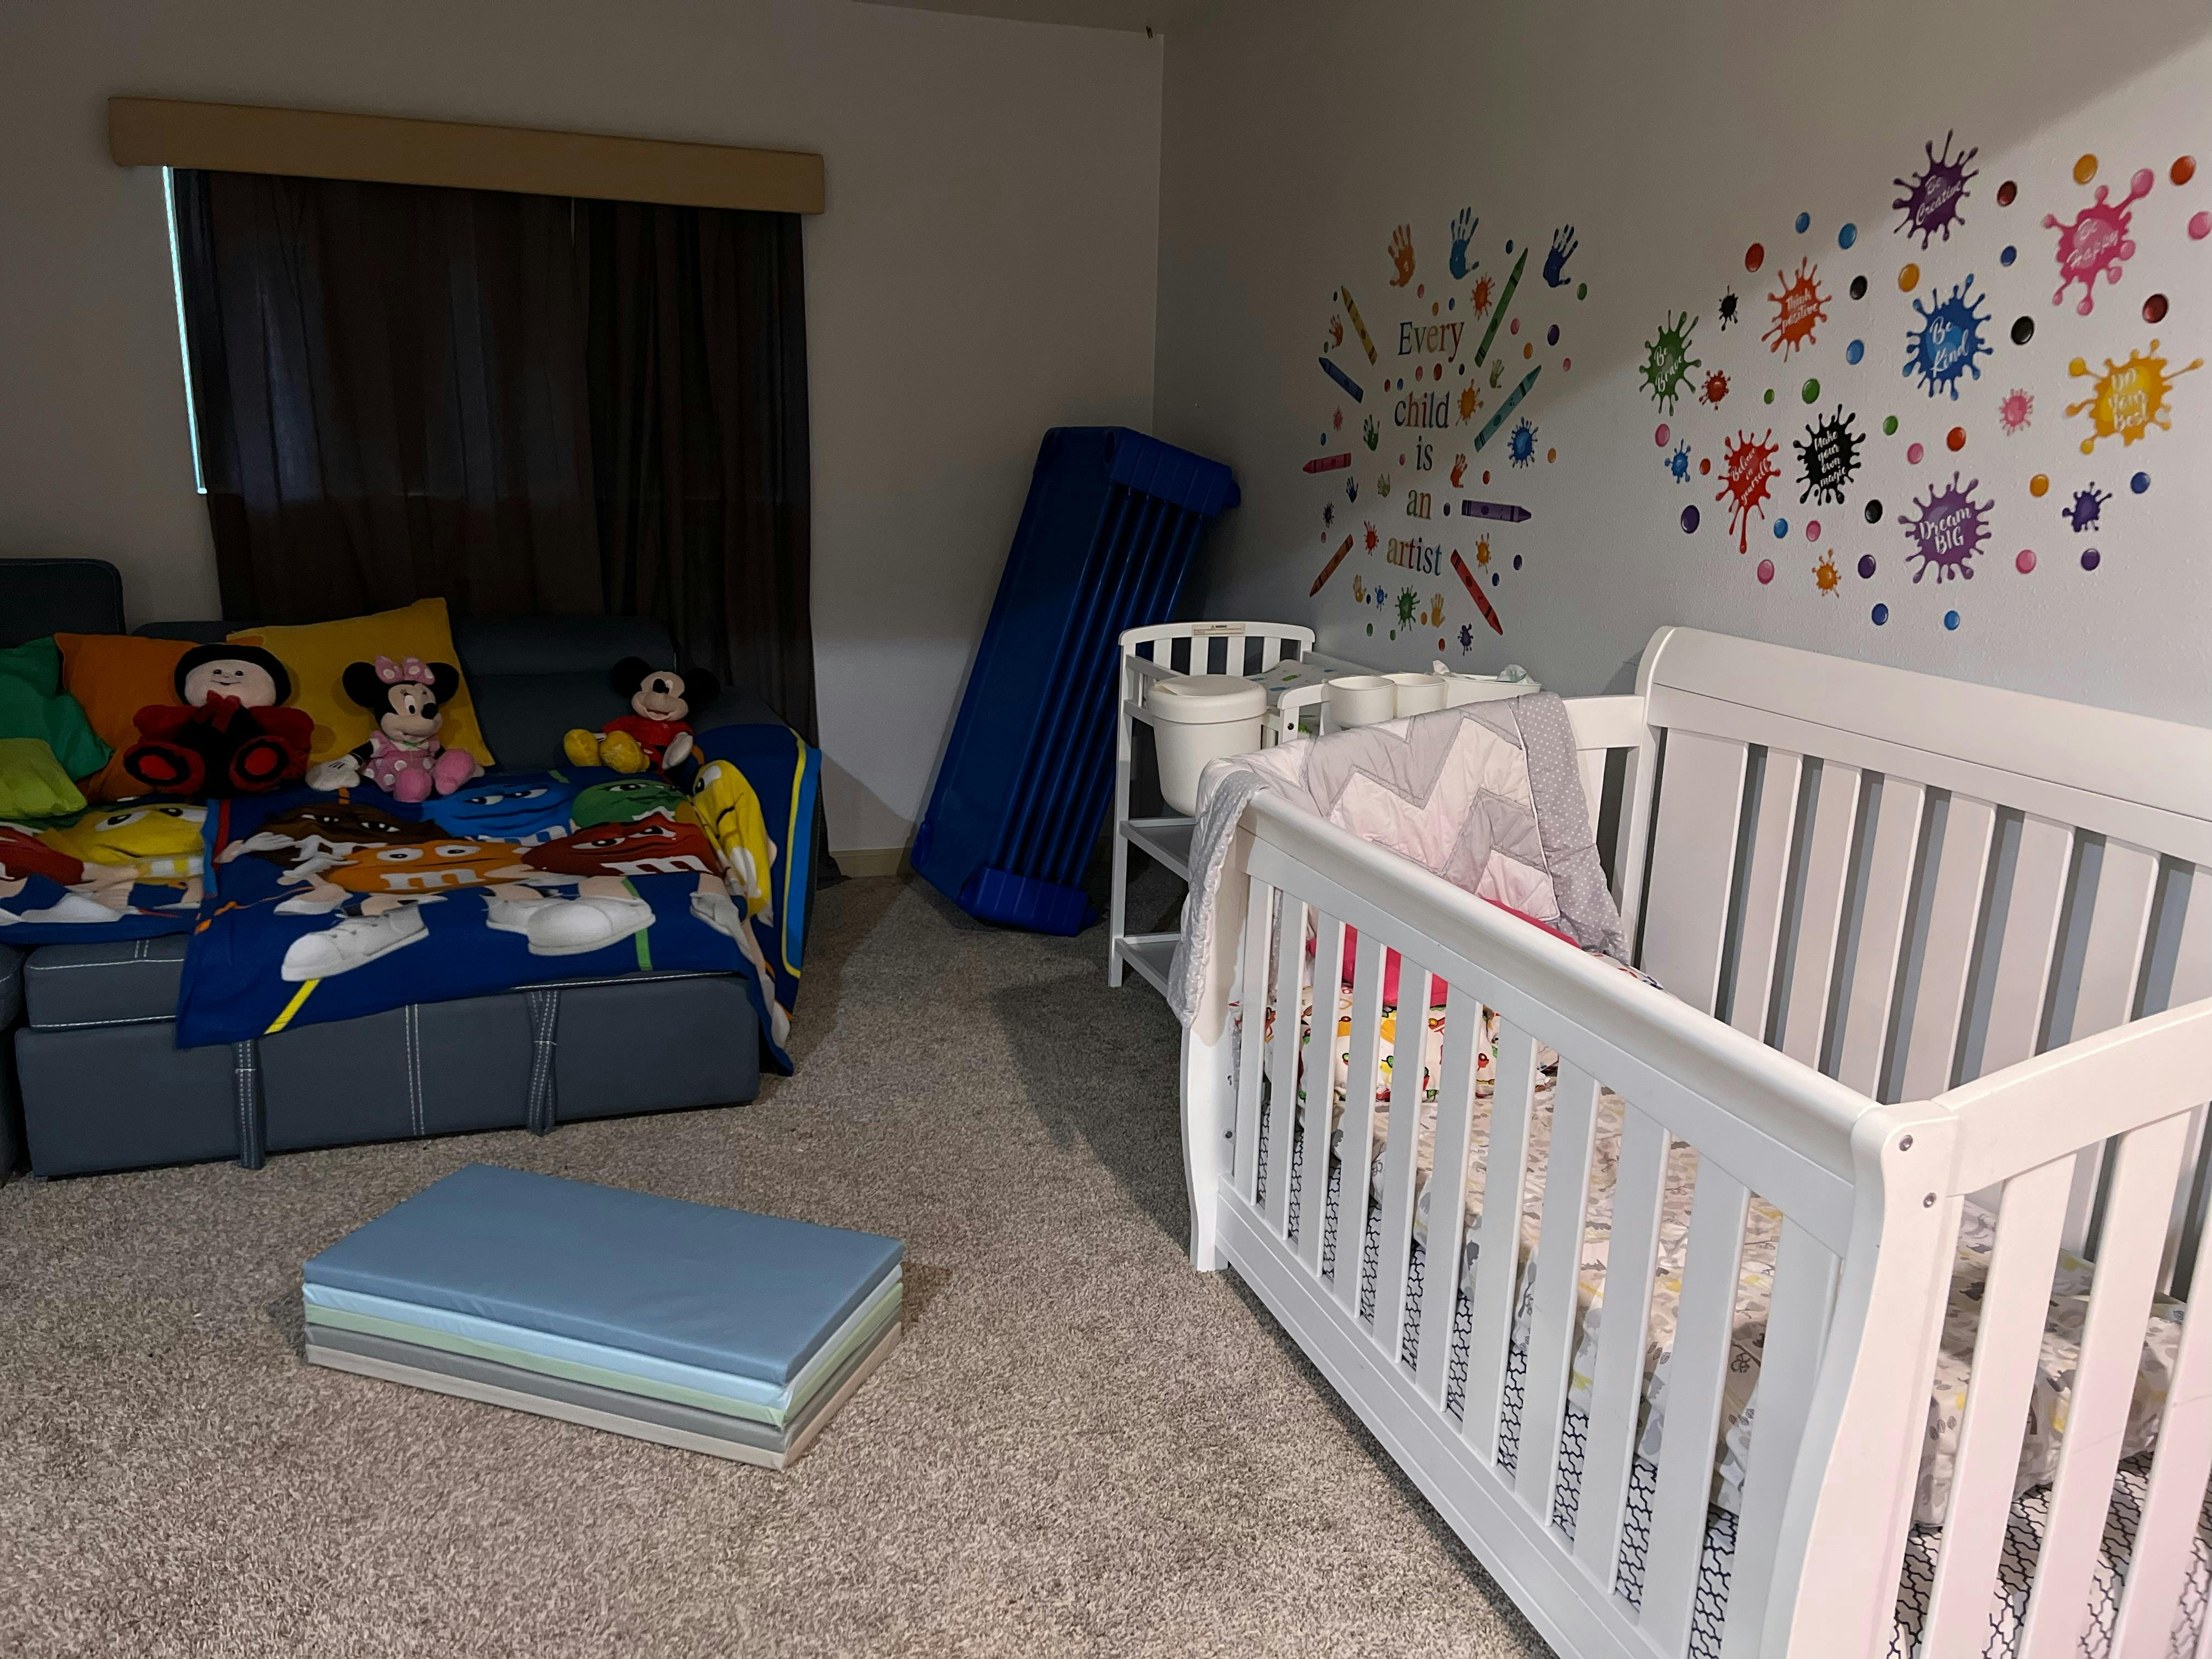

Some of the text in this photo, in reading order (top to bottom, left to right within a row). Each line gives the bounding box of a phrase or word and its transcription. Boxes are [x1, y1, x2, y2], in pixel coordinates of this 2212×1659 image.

[1925, 175, 1941, 195] Be
[1916, 180, 1961, 225] Creative
[1785, 288, 1812, 312] Think
[1782, 303, 1819, 334] positive
[1929, 316, 1952, 345] Be
[1398, 321, 1465, 363] Every
[1654, 346, 1667, 367] Be
[1930, 329, 1969, 378] Kind
[1655, 356, 1683, 392] Brave
[1394, 390, 1450, 428] child
[1417, 435, 1433, 471] is
[1814, 431, 1839, 452] Make
[1818, 444, 1840, 466] your
[1729, 448, 1756, 481] Believe
[1746, 469, 1753, 481] in
[1820, 466, 1848, 488] magic
[1821, 457, 1841, 473] own
[1741, 458, 1769, 506] yourself
[1407, 489, 1431, 520] an
[1920, 507, 1972, 540] Dream
[1934, 526, 1964, 555] BIG
[1386, 537, 1442, 576] artist
